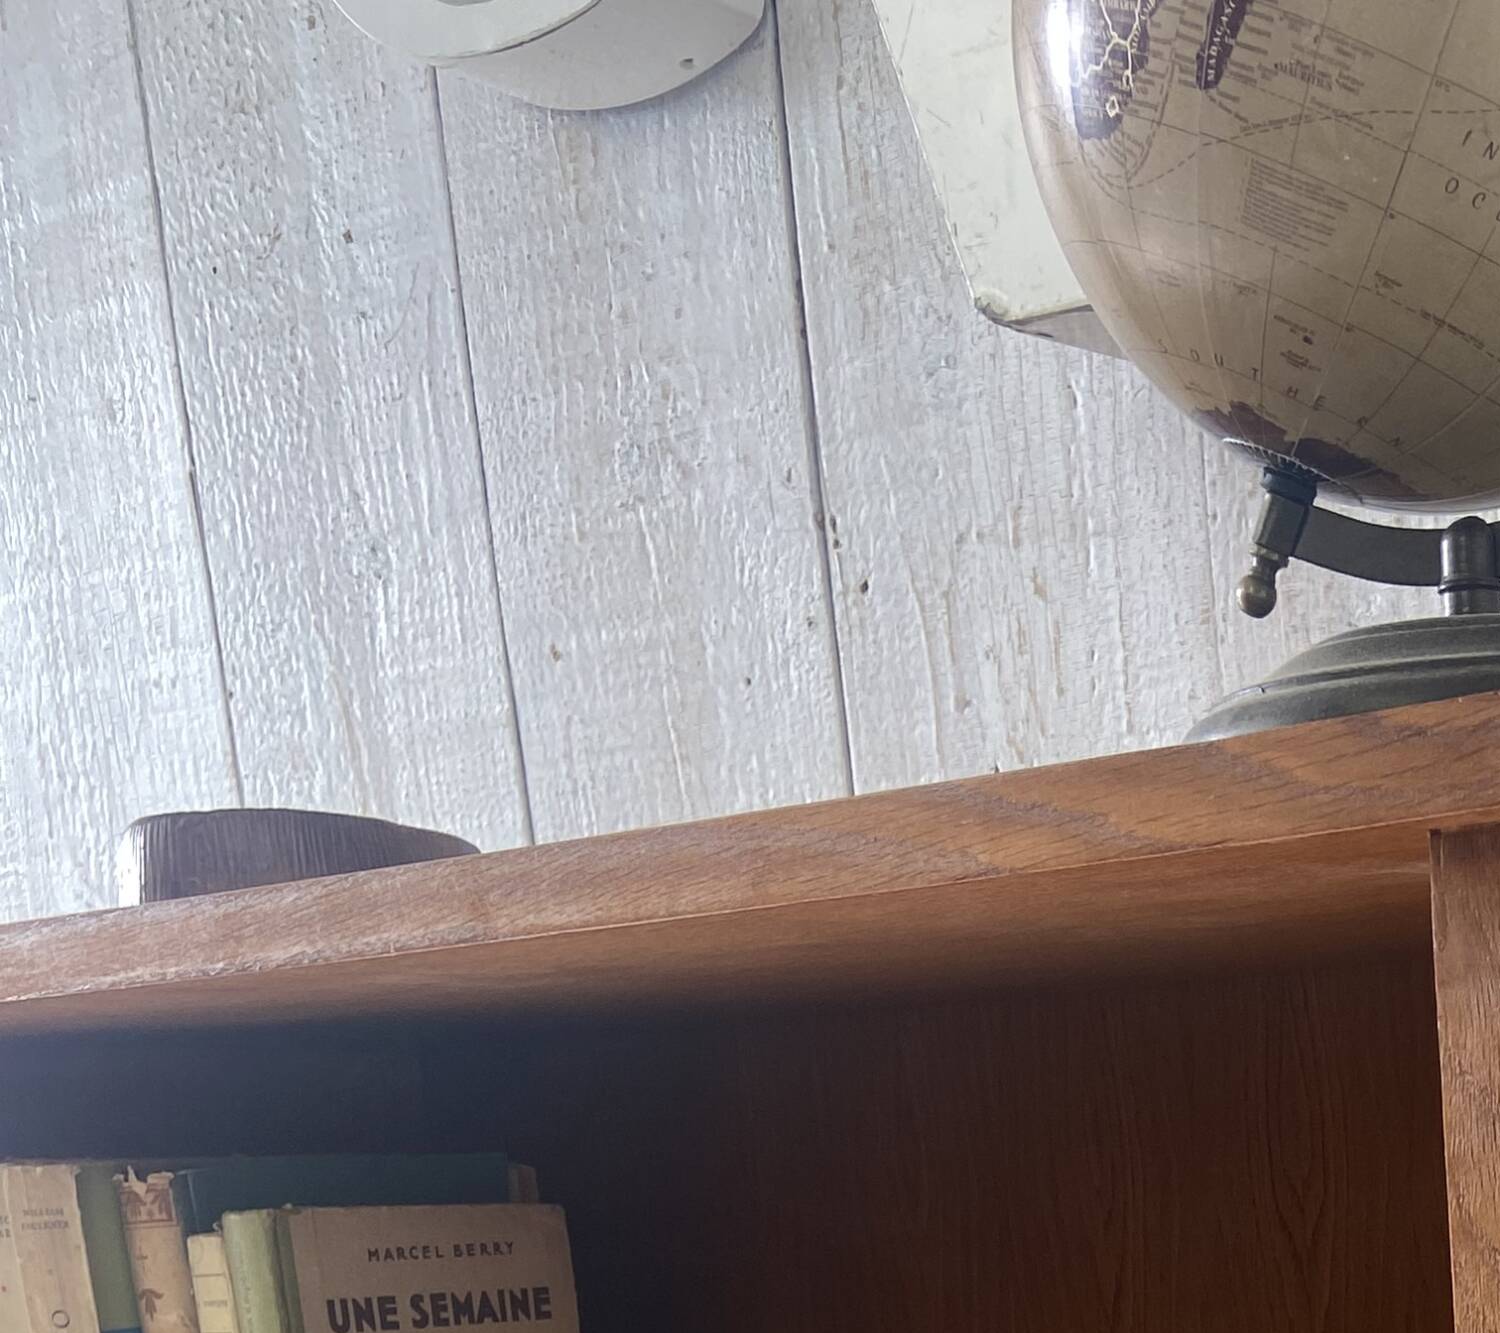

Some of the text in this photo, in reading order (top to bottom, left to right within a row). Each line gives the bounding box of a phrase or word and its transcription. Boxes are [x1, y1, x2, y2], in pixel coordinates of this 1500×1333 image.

[367, 1241, 514, 1263] MARCEL BERRY
[409, 1286, 553, 1330] SEMAINE
